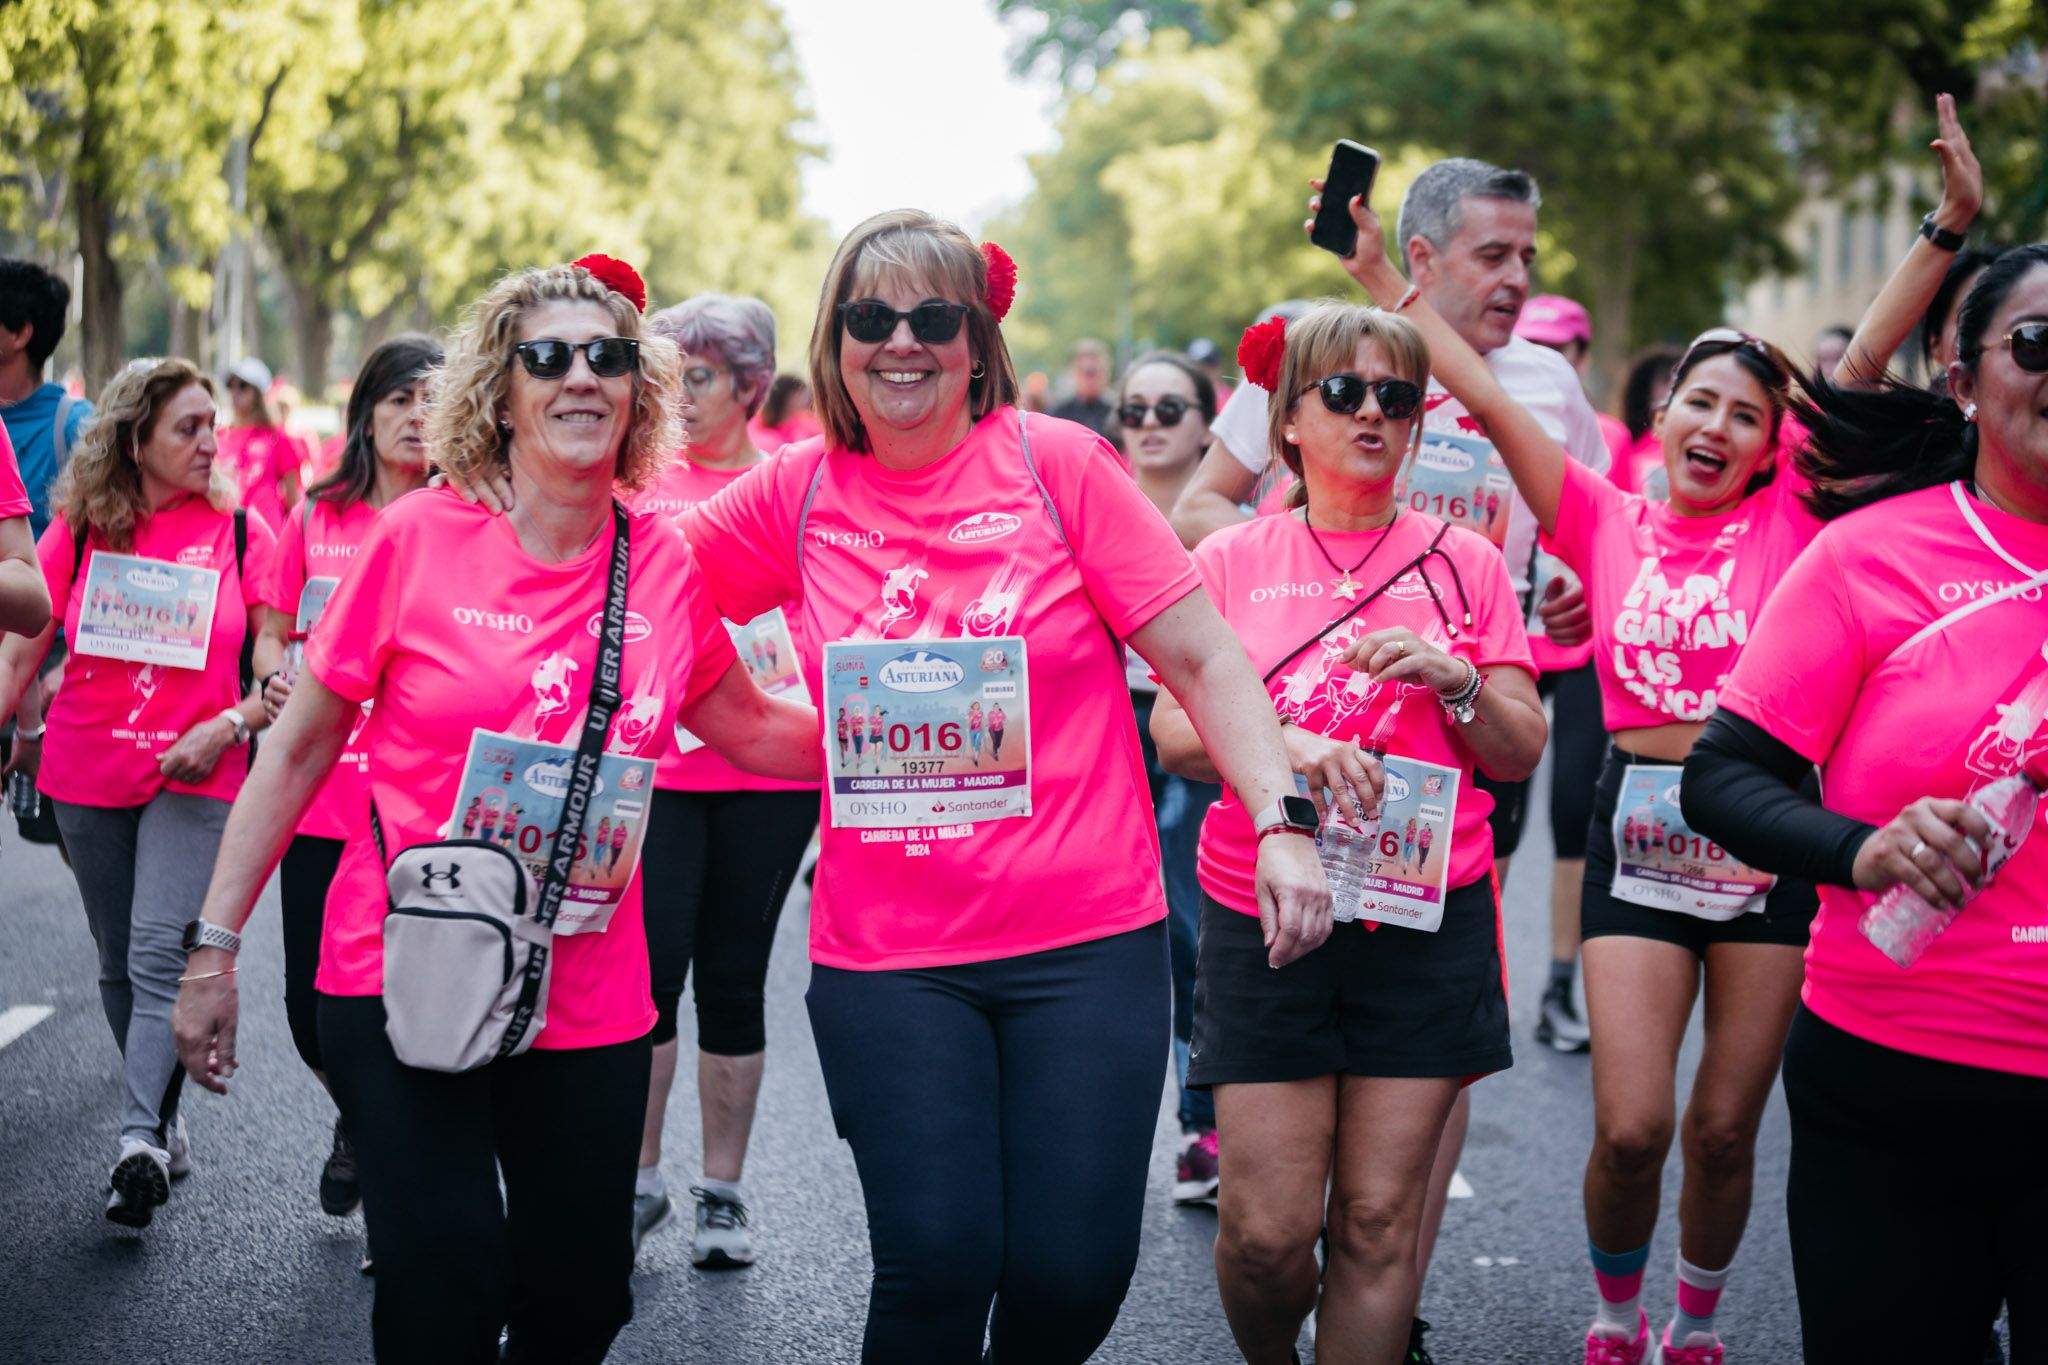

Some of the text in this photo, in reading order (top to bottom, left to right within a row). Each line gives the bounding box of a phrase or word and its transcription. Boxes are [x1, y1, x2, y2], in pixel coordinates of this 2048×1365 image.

[1410, 490, 1467, 519] 016
[815, 530, 885, 548] OYSHO
[310, 544, 359, 558] OYSHO
[606, 536, 629, 646] ARMOUR
[1250, 582, 1323, 602] OYSHO
[1939, 581, 2043, 602] OYSHO
[125, 604, 170, 624] 016
[452, 607, 534, 633] OYSHO
[835, 661, 865, 672] SUMA
[884, 667, 959, 684] ASTURIANA
[888, 721, 963, 752] 016
[901, 760, 945, 775] 19377
[850, 775, 1005, 790] CARRERA DE LA MUJER MADRID
[553, 753, 597, 878] ARMOUR
[850, 799, 1008, 815] OYSHO Santander
[860, 823, 974, 843] CARRERA DE LA MUJER
[905, 844, 931, 857] 2024
[1667, 833, 1726, 862] 016
[1393, 882, 1425, 897] MADRID
[1632, 884, 1683, 902] OYSHO
[1377, 901, 1424, 919] Santander
[2011, 926, 2048, 944] CARR
